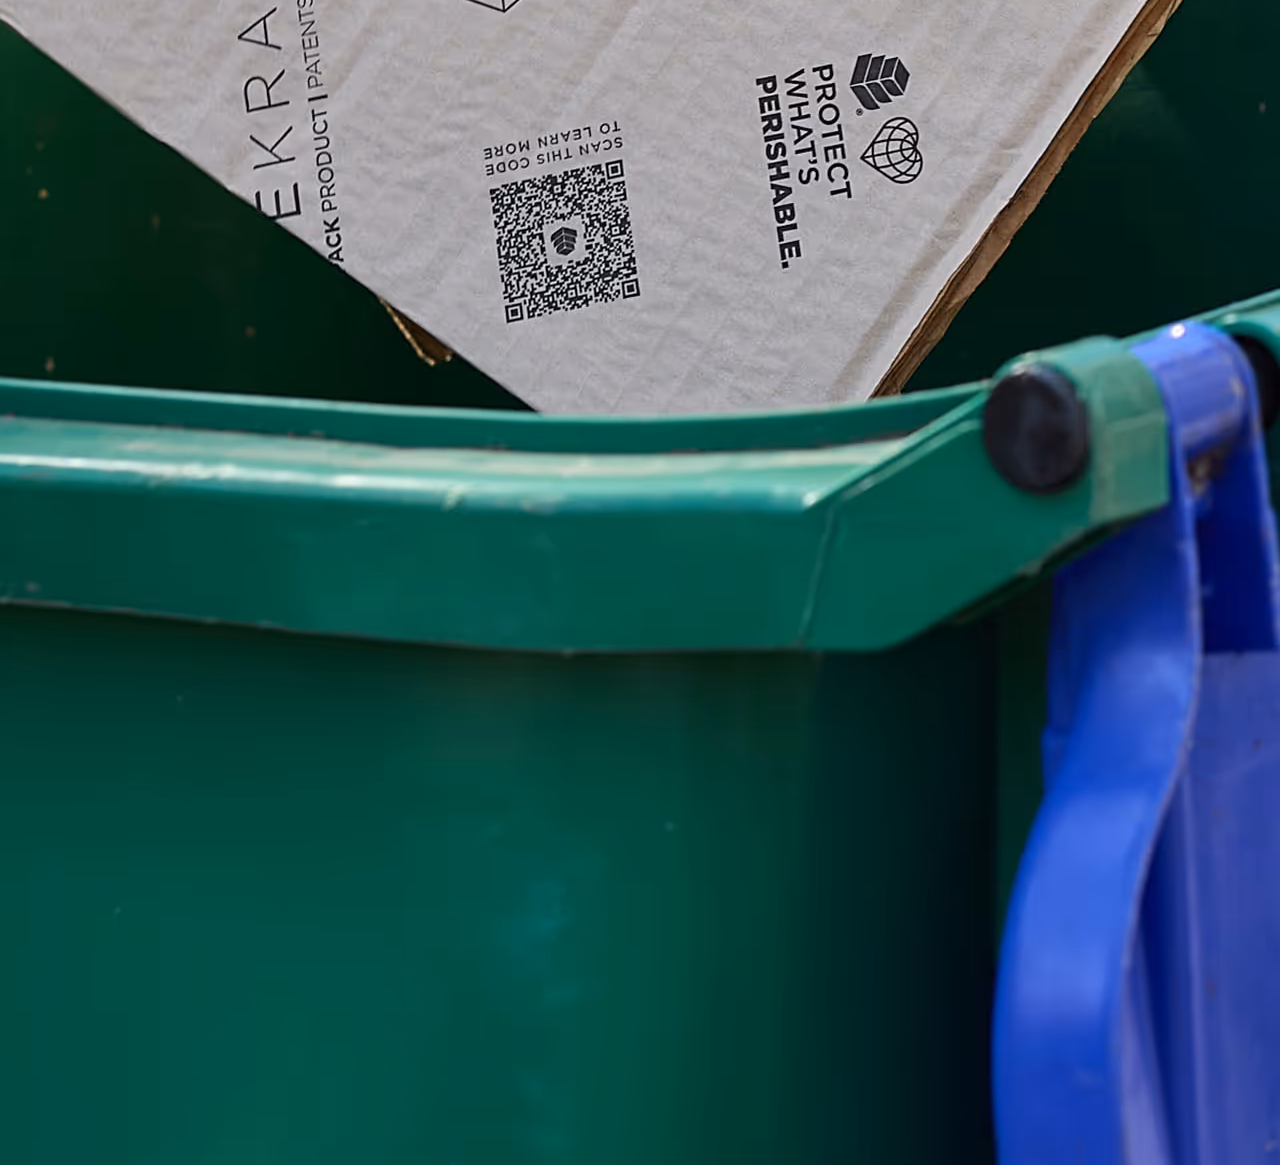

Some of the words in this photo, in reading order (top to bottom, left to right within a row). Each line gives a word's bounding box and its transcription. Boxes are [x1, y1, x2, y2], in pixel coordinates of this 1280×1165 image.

[537, 125, 593, 149] LEARN
[598, 120, 621, 135] TO
[784, 67, 820, 185] WHAT'S
[811, 63, 853, 199] PROTECT
[483, 139, 531, 160] MORE
[536, 147, 573, 165] THIS
[578, 136, 624, 156] SCAN
[311, 108, 338, 213] PRODUCT
[484, 156, 530, 176] CODE
[755, 74, 802, 270] PERISHABLE.
